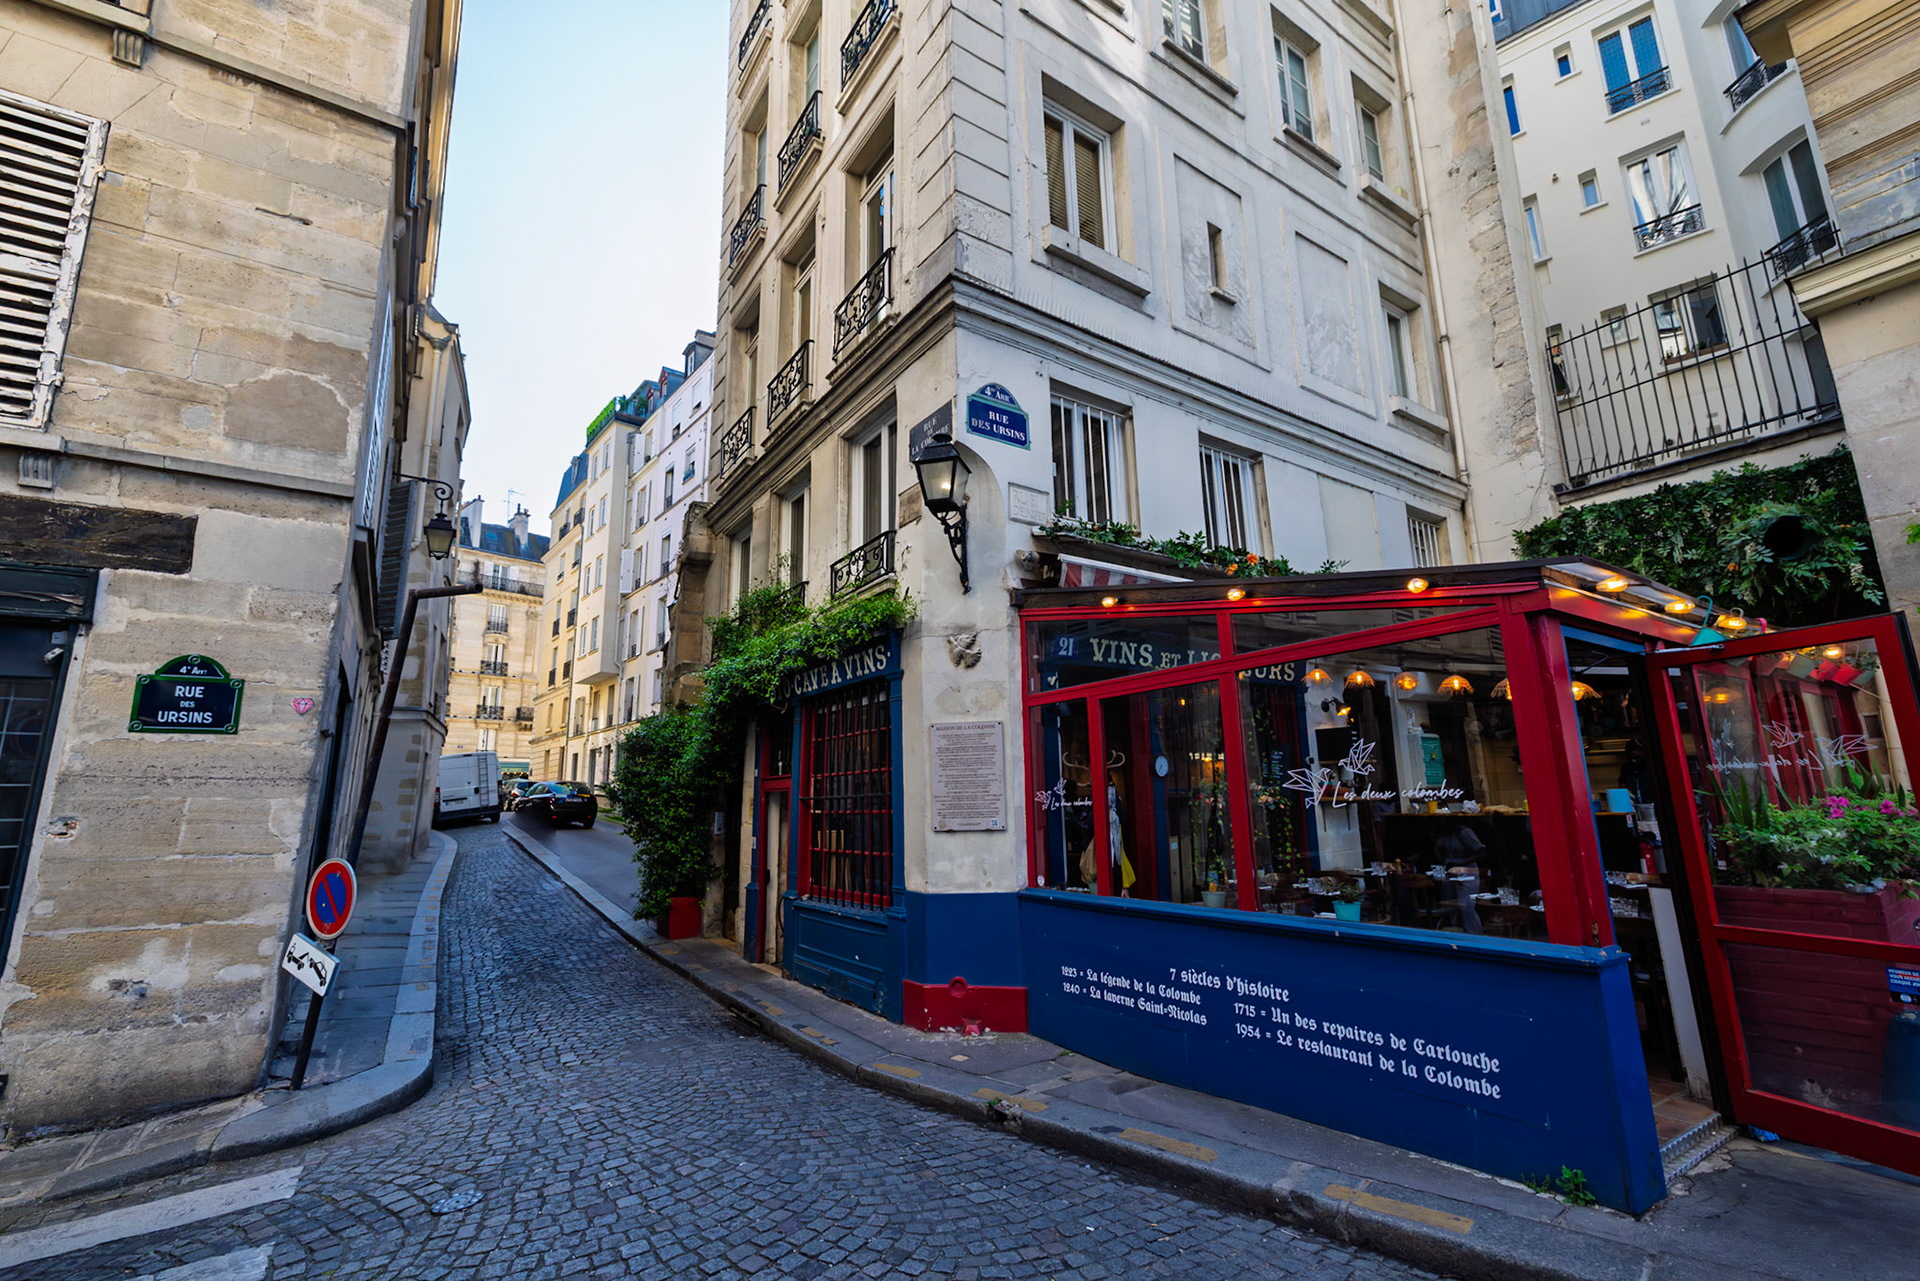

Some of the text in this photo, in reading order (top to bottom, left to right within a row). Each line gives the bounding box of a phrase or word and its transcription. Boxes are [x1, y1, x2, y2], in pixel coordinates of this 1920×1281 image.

[923, 416, 938, 432] RUE
[971, 417, 1026, 442] DES URSINS
[989, 411, 1009, 425] RUE
[1058, 637, 1074, 656] 21
[1089, 638, 1153, 667] VINS
[1161, 651, 1181, 669] ET
[174, 685, 205, 698] RUE
[794, 665, 829, 695] CAVE
[157, 710, 213, 724] URSINS
[179, 700, 196, 708] DES
[1332, 778, 1464, 808] Les deux colombes
[1061, 966, 1077, 978] 1223
[1086, 968, 1098, 982] La
[1100, 972, 1130, 989] légende
[1134, 979, 1143, 992] de
[1146, 981, 1155, 995] la
[1159, 984, 1201, 1005] Colombe
[1063, 982, 1080, 994] 1240
[1090, 985, 1101, 999] La
[1104, 989, 1135, 1008] taverne
[1170, 968, 1289, 1002] 7 siècles d'histoire
[1234, 1002, 1256, 1018] 1715
[1271, 1006, 1290, 1025] Un
[1295, 1013, 1317, 1031] des
[1323, 1021, 1384, 1046] repaires
[1390, 1033, 1407, 1051] de
[1413, 1038, 1500, 1073] Cartouche
[1235, 1023, 1261, 1039] 1954
[1277, 1029, 1293, 1047] Le
[1297, 1037, 1373, 1067] restaurant
[1379, 1054, 1395, 1073] de
[1401, 1059, 1418, 1079] la
[1424, 1065, 1502, 1099] Colombe
